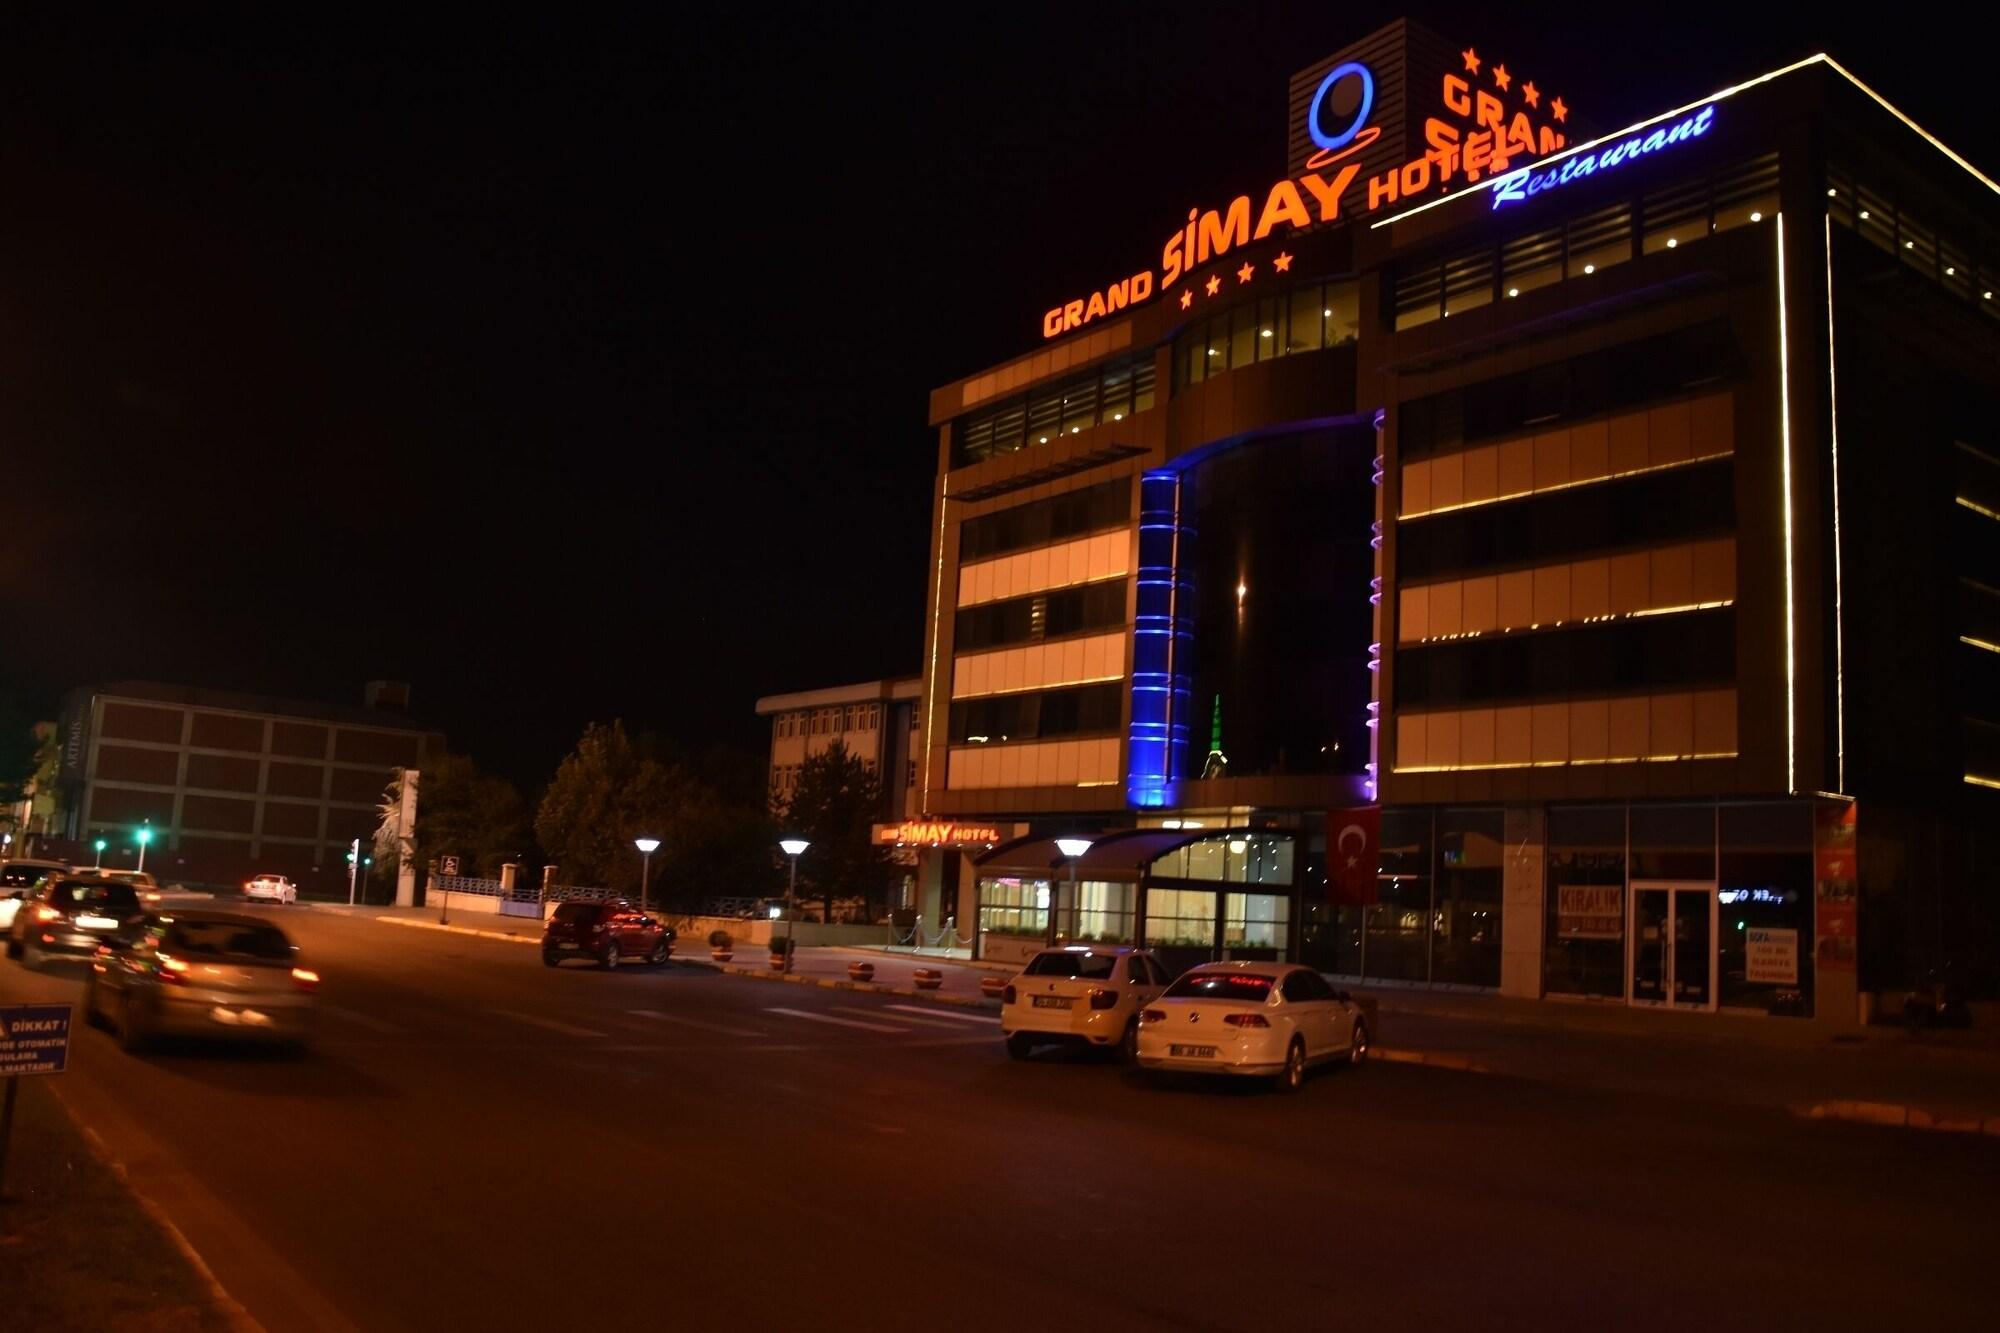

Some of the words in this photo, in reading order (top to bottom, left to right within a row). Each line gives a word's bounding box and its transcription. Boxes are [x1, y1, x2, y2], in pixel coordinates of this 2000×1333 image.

[1492, 105, 1714, 210] Restaurant
[1043, 270, 1153, 338] GRAND
[1161, 163, 1361, 290] SİMAY
[1368, 125, 1525, 211] HOTEL
[952, 828, 999, 841] HOTEL
